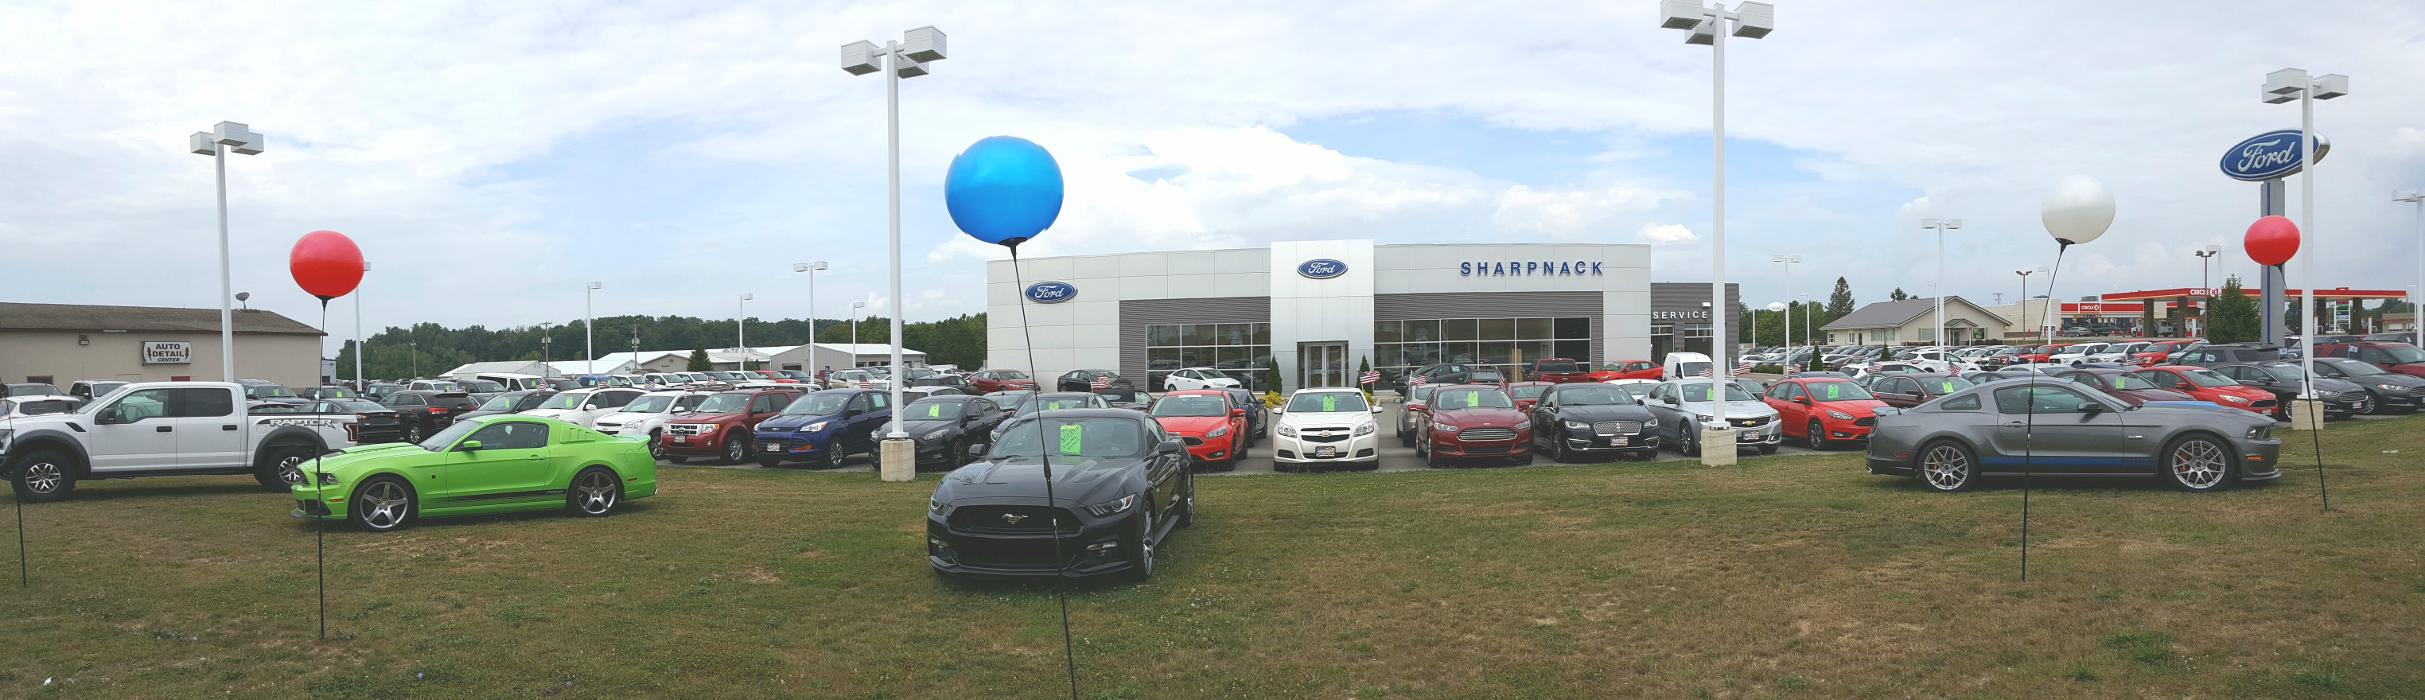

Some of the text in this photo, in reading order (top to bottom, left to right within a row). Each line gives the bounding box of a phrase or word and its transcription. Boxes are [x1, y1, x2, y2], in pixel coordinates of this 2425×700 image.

[2238, 138, 2296, 172] Ford
[1308, 262, 1336, 274] Ford
[1460, 261, 1603, 275] SHARPNACK
[1034, 285, 1065, 298] Ford
[1653, 311, 1708, 319] SERVICE
[270, 418, 335, 428] RAPTOR
